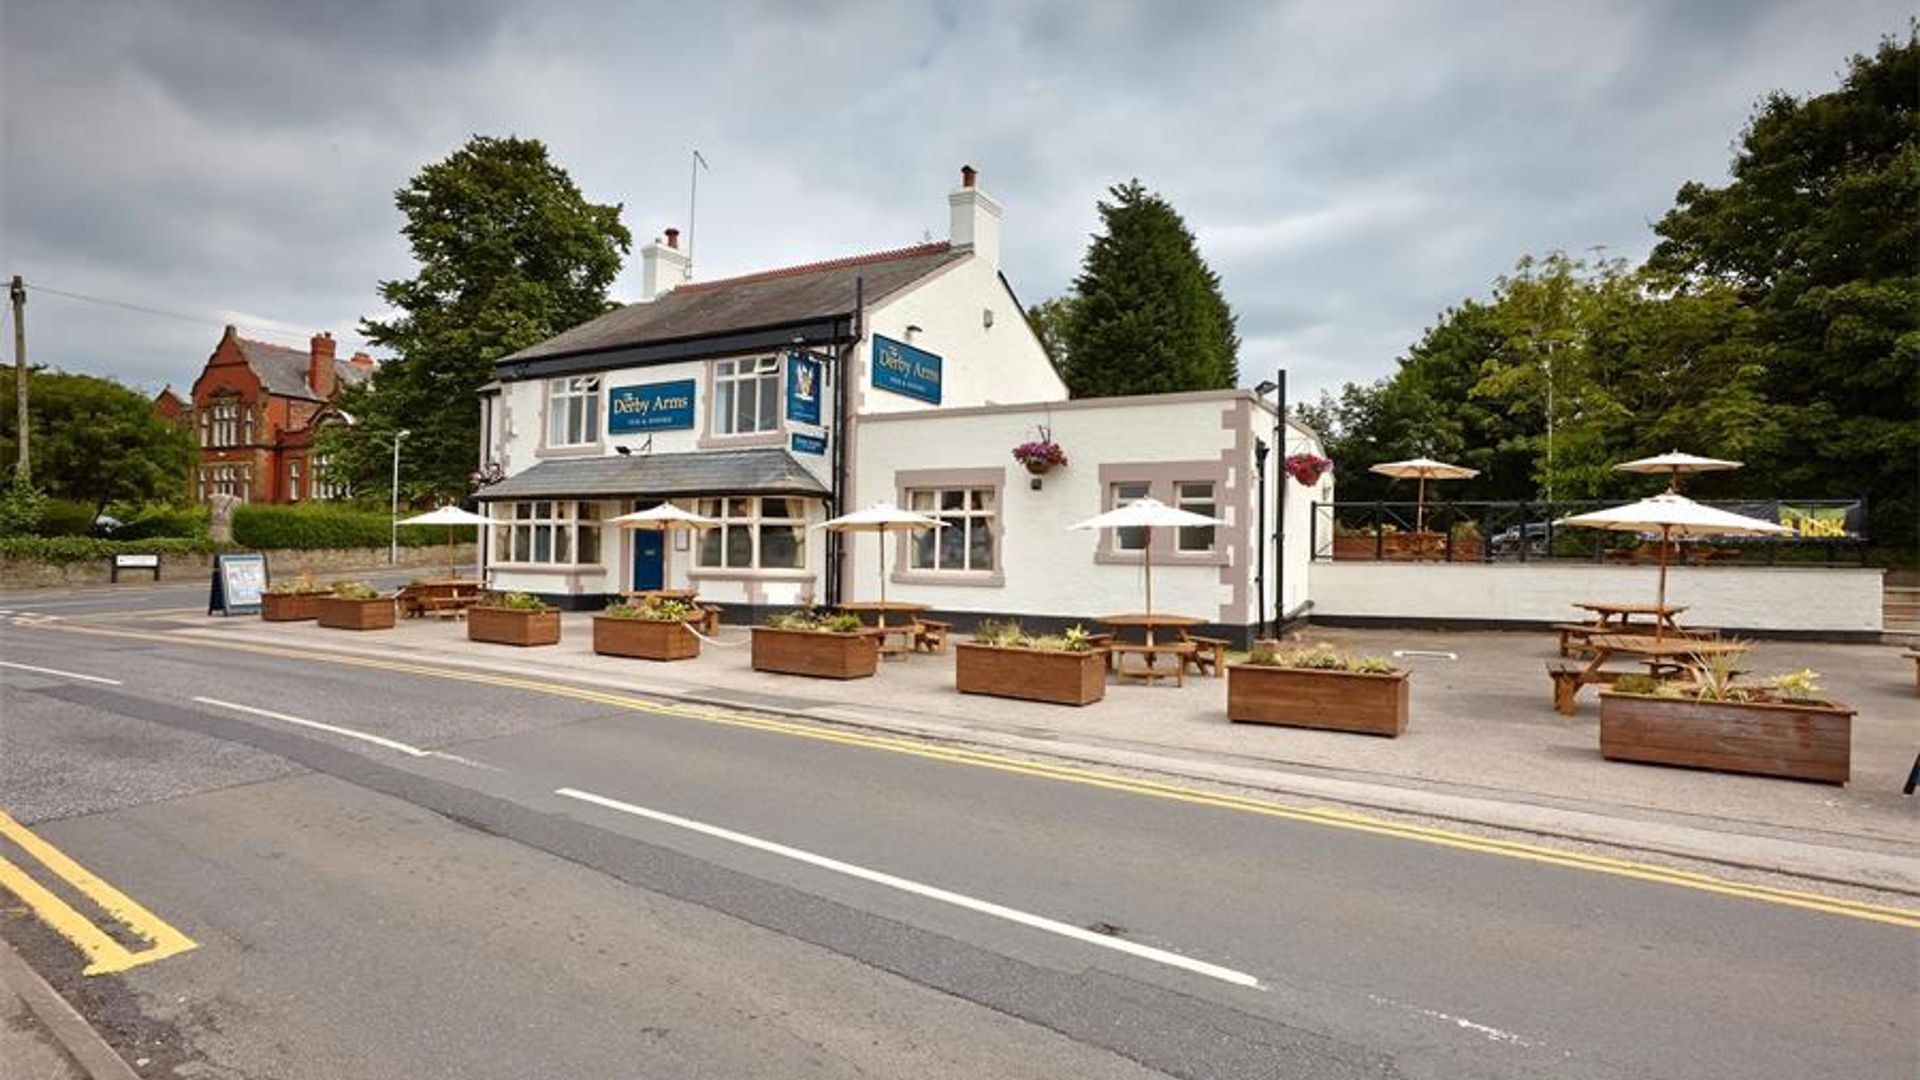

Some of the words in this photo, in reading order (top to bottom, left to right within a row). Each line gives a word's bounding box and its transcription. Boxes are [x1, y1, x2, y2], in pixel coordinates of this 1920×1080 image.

[879, 348, 911, 378] Derby
[913, 362, 940, 383] Arms
[613, 396, 650, 416] Derby
[653, 395, 689, 411] Arms
